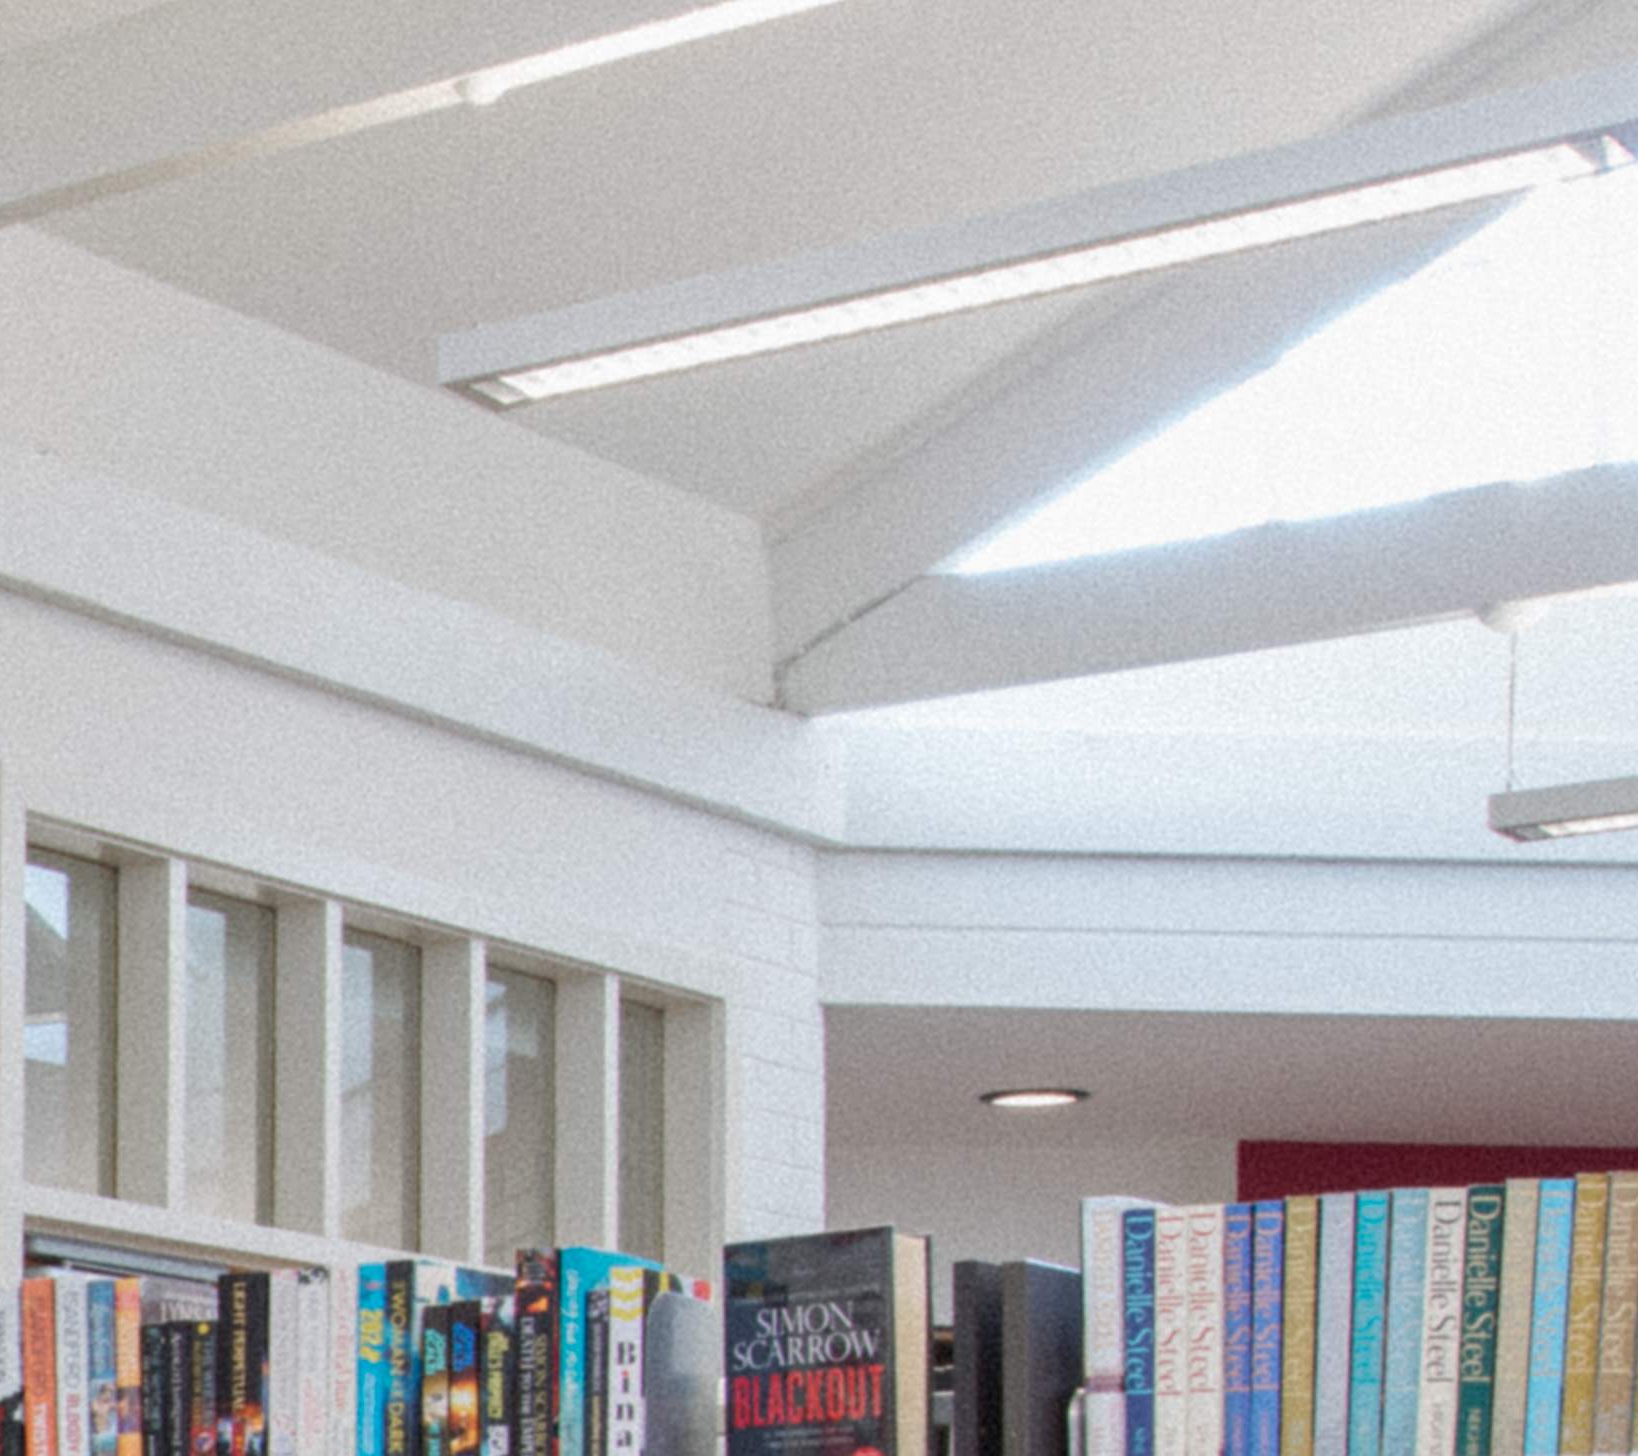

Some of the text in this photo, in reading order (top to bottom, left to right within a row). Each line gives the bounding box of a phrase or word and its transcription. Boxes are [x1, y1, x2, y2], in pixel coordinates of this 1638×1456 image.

[756, 1300, 857, 1337] SIMON
[1425, 1199, 1462, 1384] Danielle Steel
[1464, 1194, 1501, 1384] Danielle Steel
[732, 1330, 883, 1371] SCARROW
[732, 1363, 886, 1430] BLACKOUT
